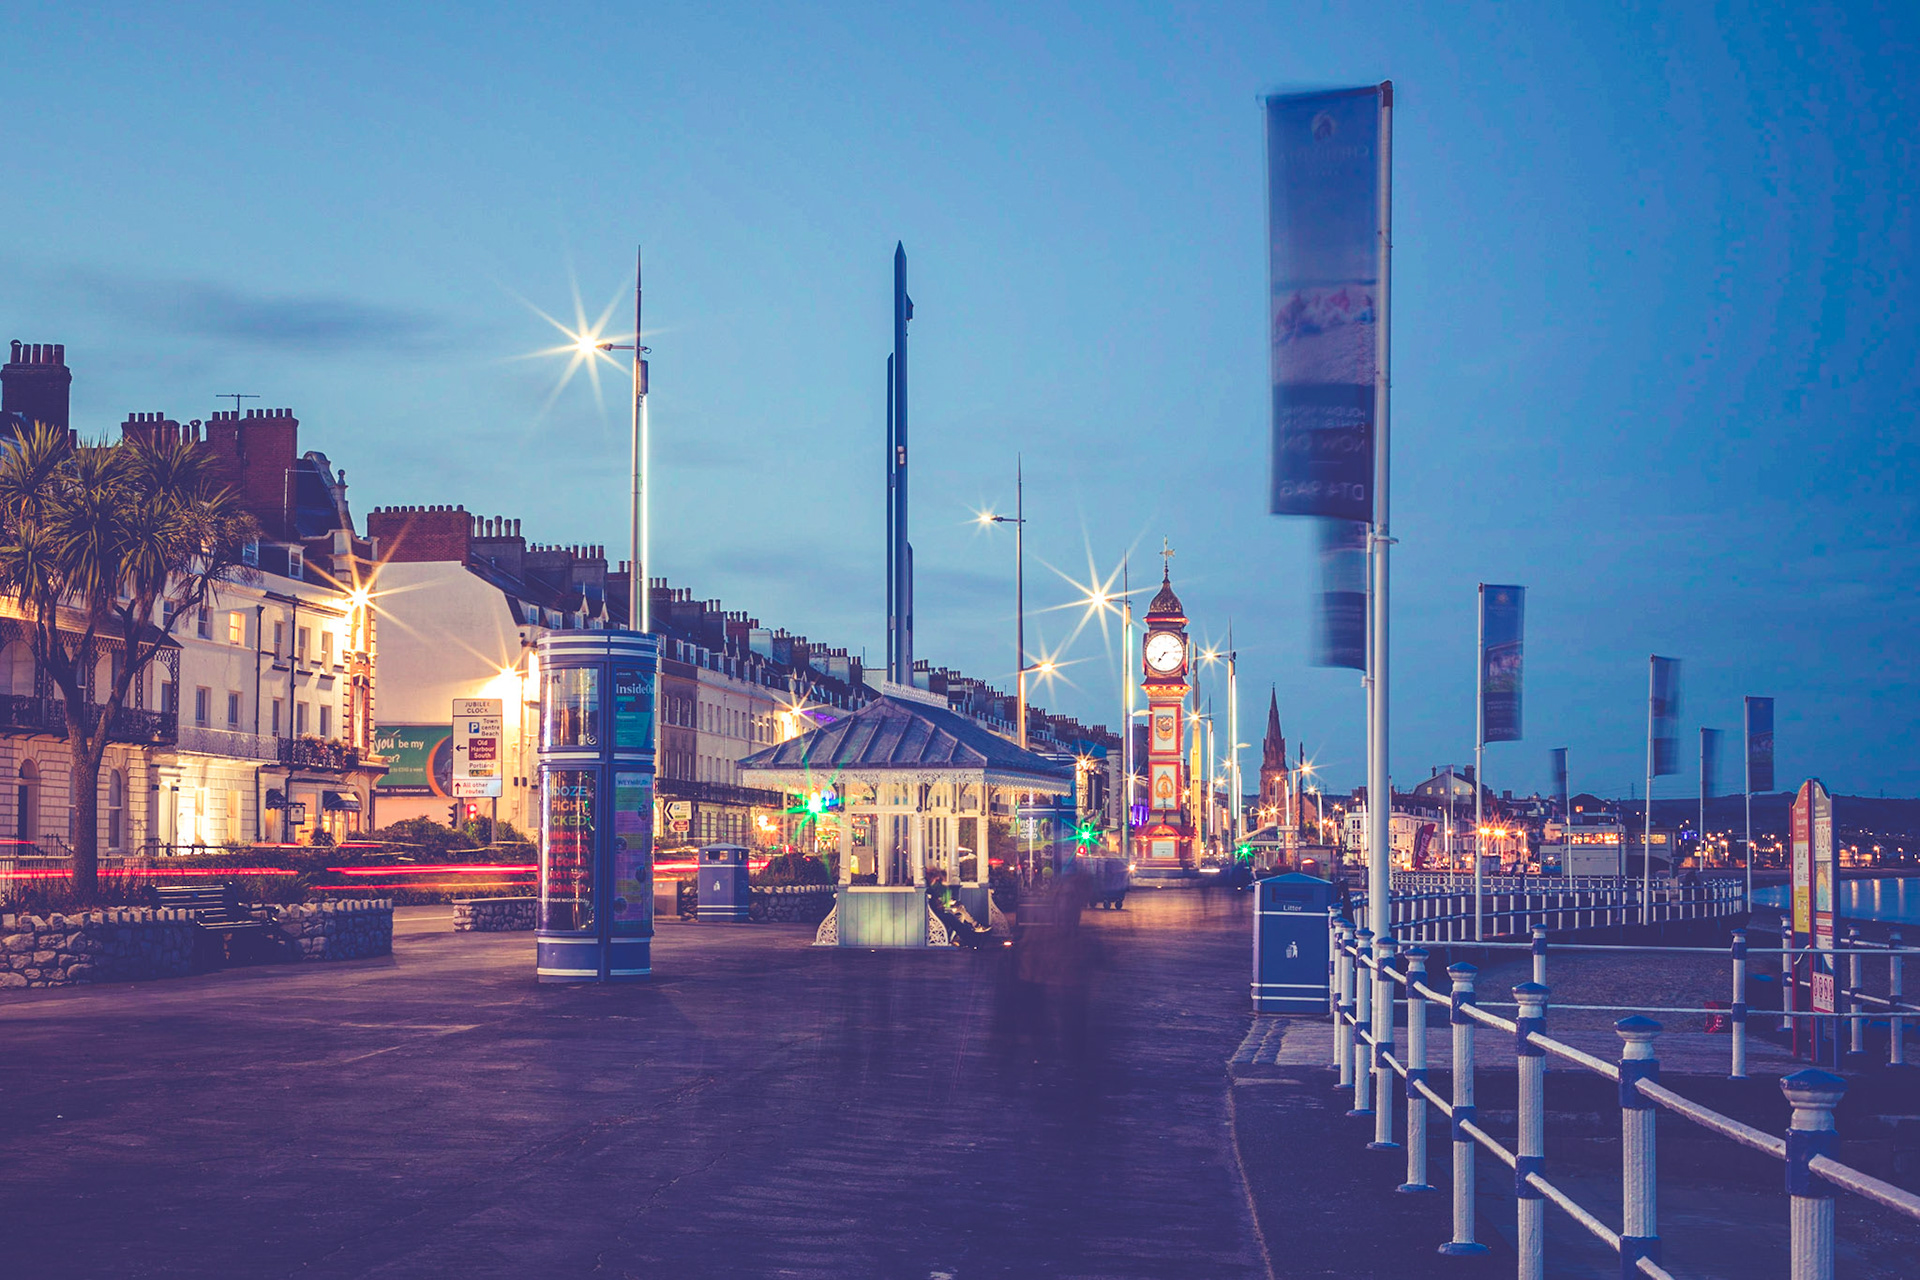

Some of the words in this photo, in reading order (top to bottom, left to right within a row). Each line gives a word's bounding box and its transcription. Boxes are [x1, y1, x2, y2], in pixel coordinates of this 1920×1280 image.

[398, 740, 409, 748] be
[410, 741, 424, 750] my
[552, 786, 587, 796] OOZE
[550, 815, 587, 826] ICKED
